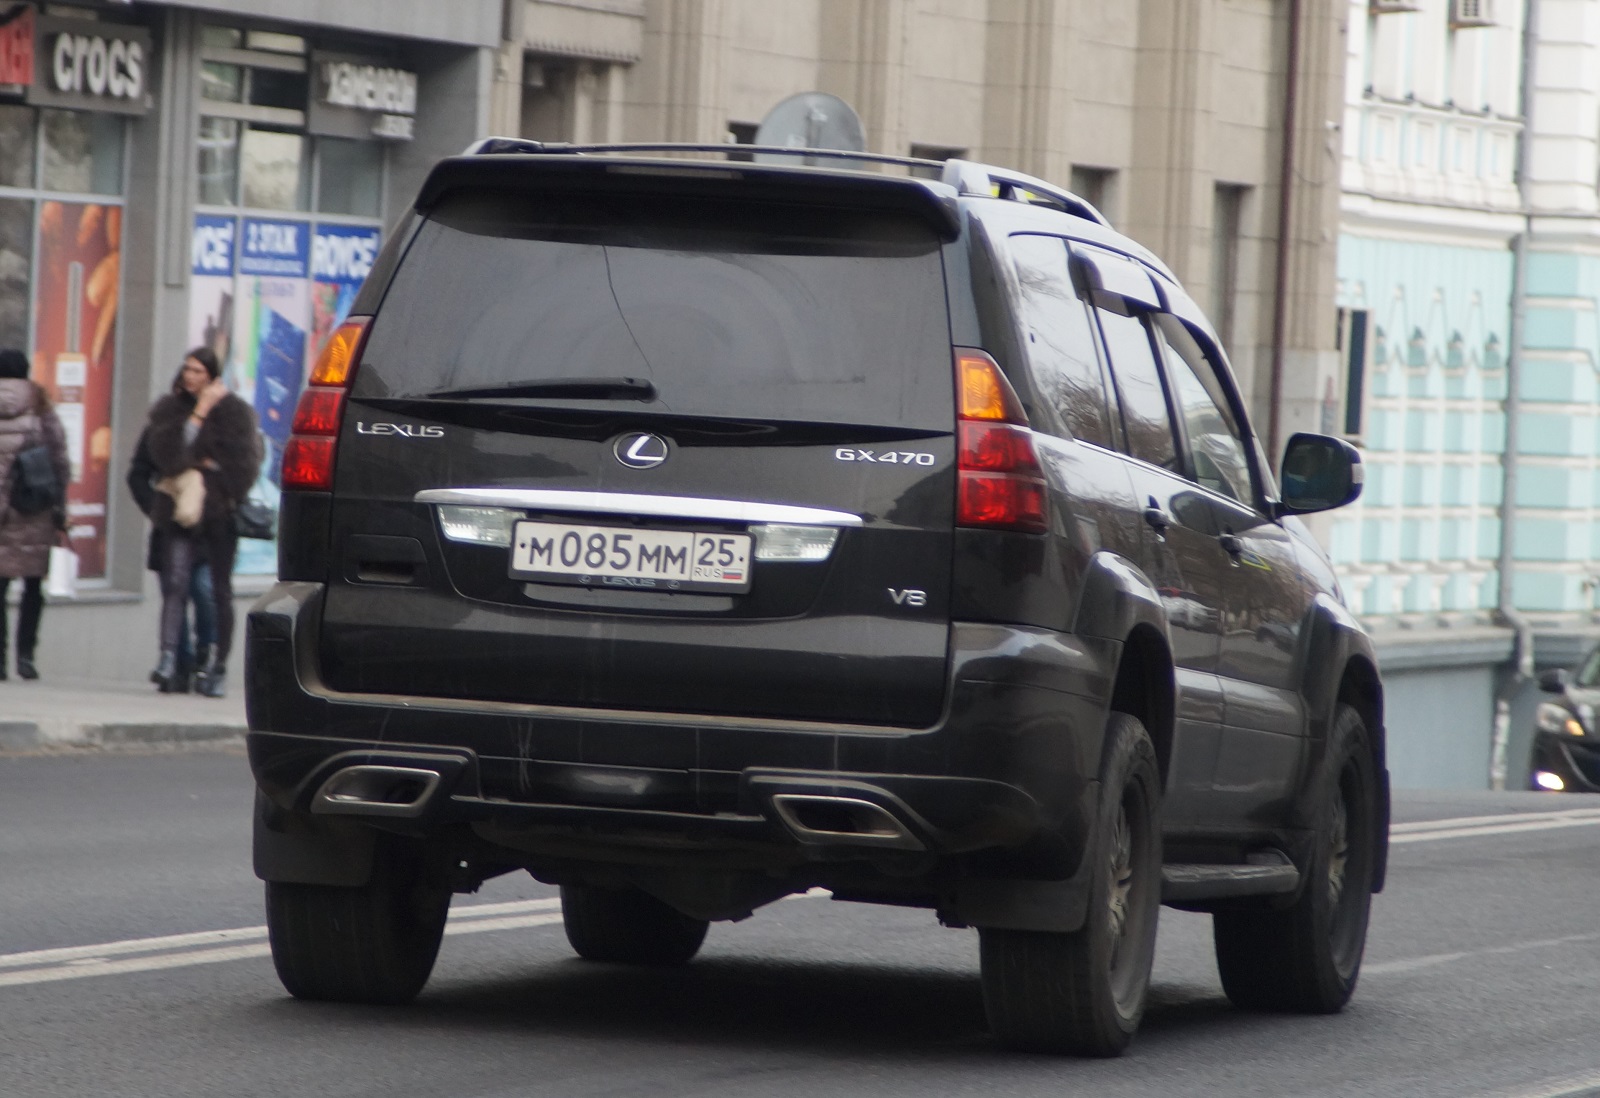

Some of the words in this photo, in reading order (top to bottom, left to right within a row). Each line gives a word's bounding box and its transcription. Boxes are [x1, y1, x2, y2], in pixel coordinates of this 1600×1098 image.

[53, 32, 143, 98] crocs
[357, 421, 445, 438] LEXUS
[835, 448, 935, 466] GX470
[698, 537, 735, 567] 25
[694, 566, 722, 578] RUS
[602, 575, 656, 588] LEXUS
[887, 587, 928, 606] V8
